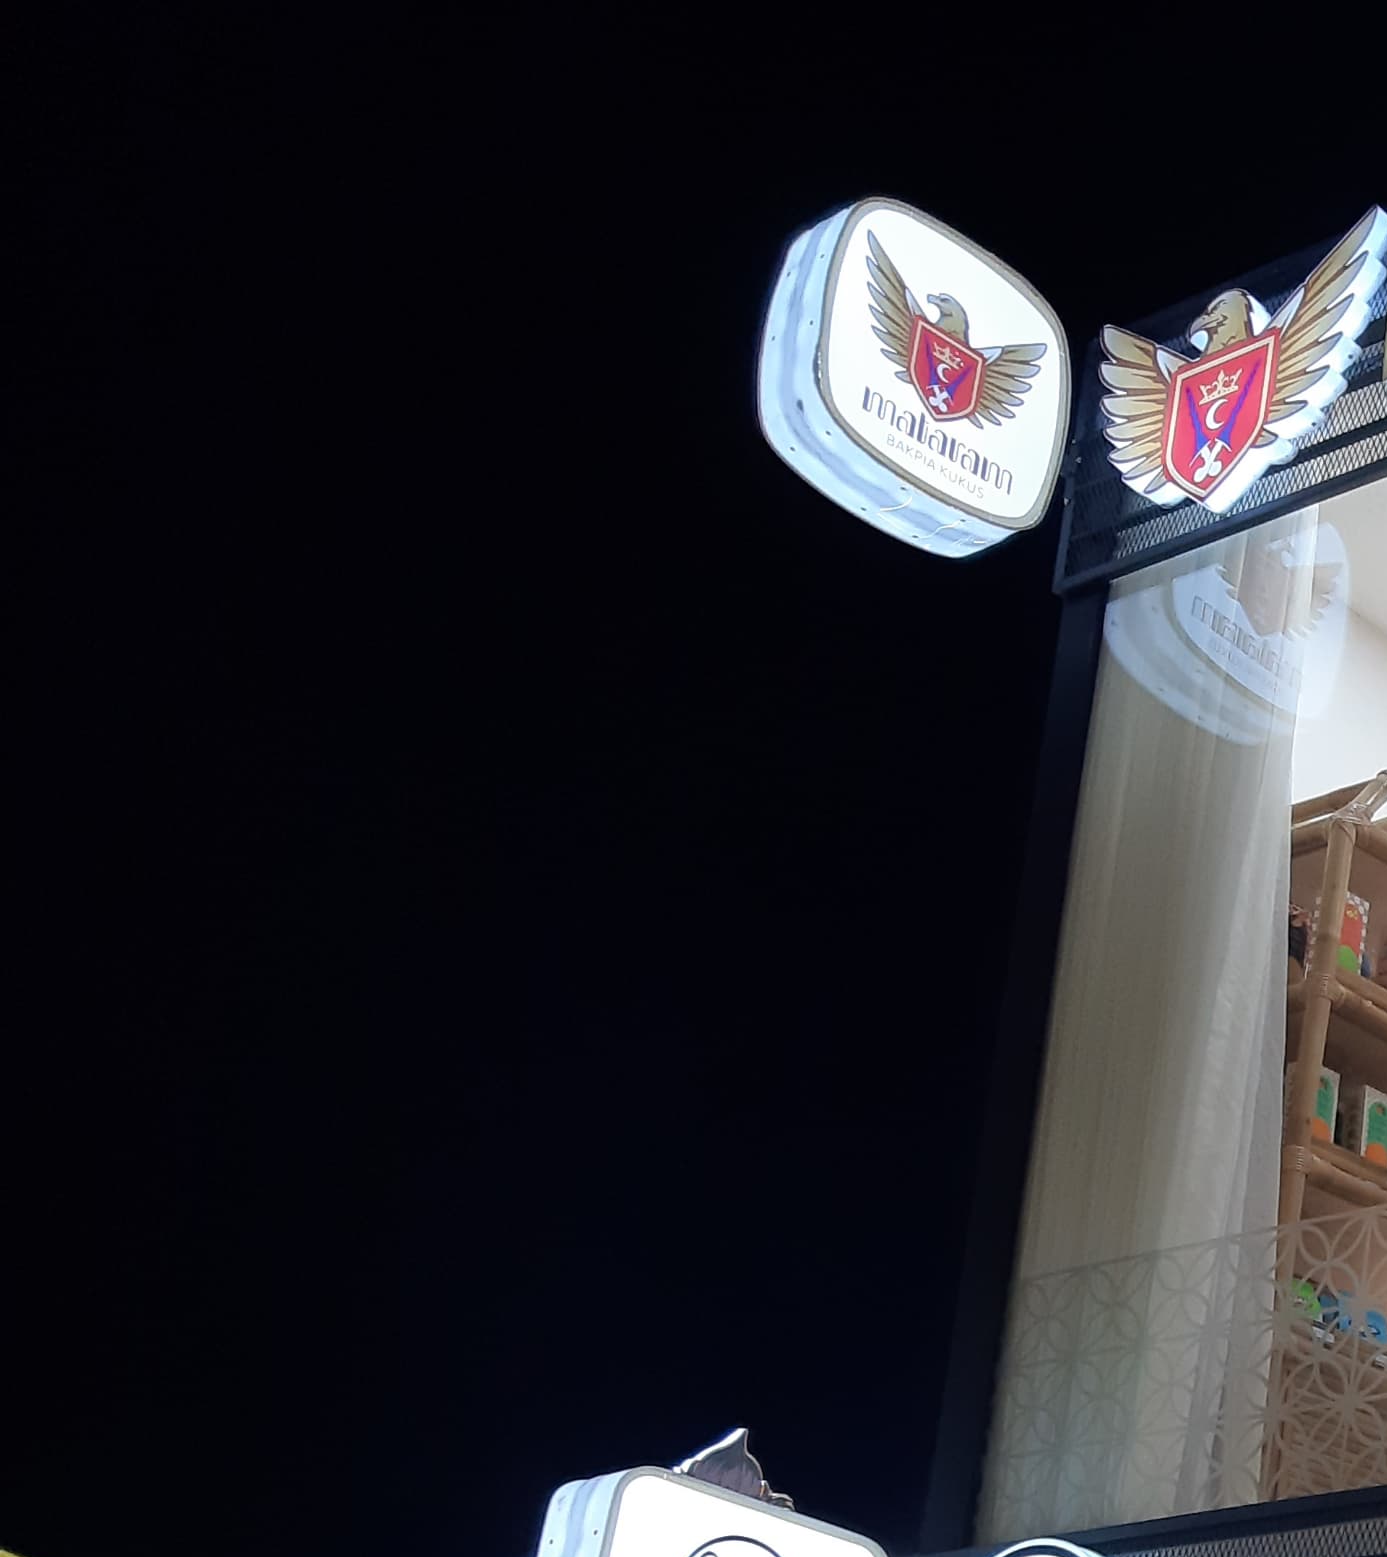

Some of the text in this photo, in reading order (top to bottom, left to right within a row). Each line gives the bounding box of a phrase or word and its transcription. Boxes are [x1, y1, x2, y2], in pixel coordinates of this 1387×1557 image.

[862, 386, 1013, 495] mataram
[886, 433, 985, 499] BAKPIA KUKUS
